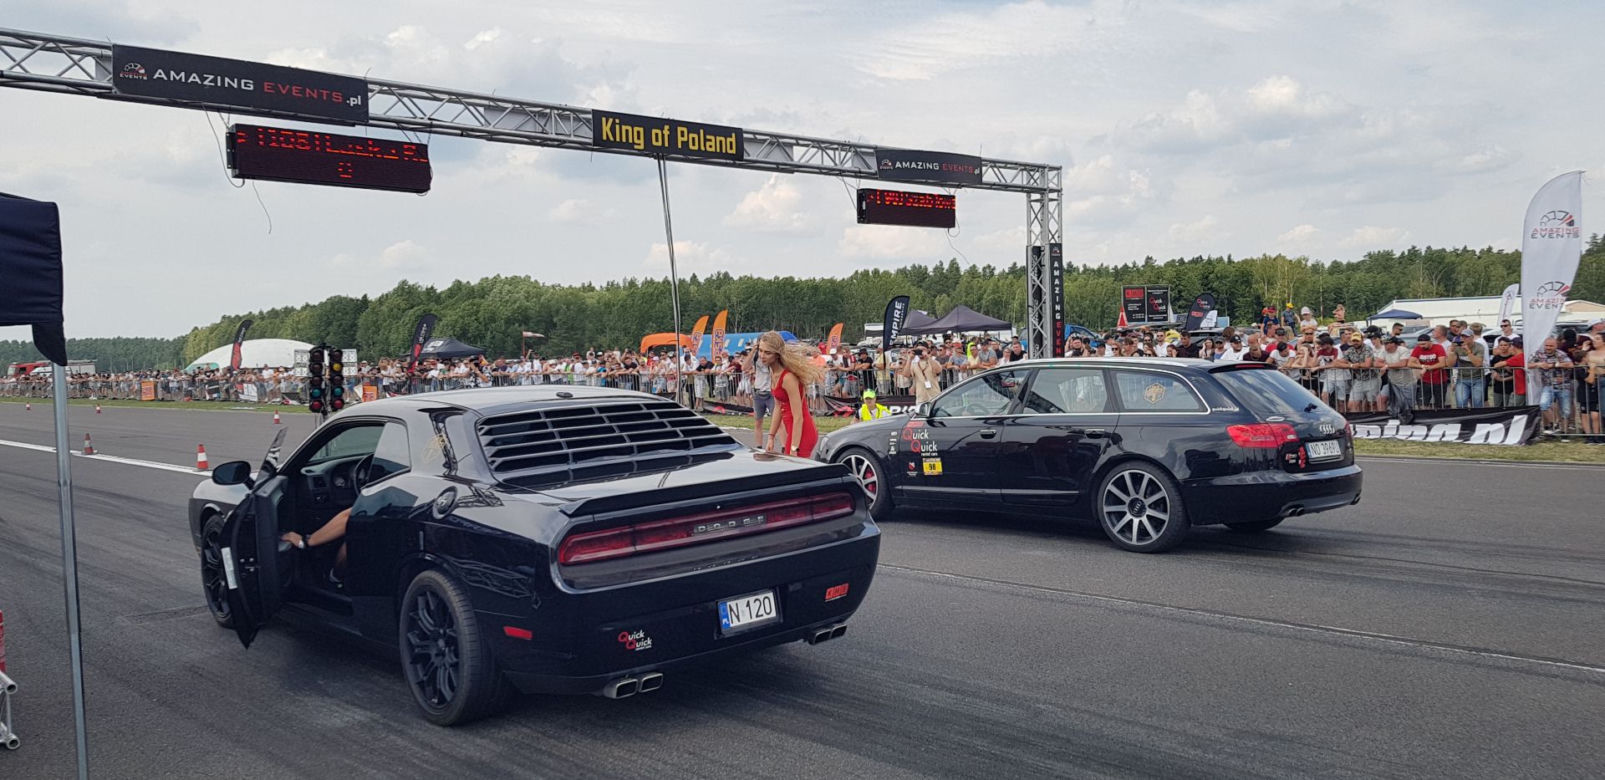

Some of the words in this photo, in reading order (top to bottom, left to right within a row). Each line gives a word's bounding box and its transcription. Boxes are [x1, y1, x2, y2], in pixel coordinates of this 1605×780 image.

[153, 69, 254, 91] AMAZING
[263, 81, 343, 103] EVENTS
[346, 95, 362, 107] .pl
[601, 116, 645, 150] King
[651, 124, 670, 148] of
[677, 126, 737, 155] Poland
[895, 161, 940, 171] AMAZING
[942, 163, 973, 175] EVENTS
[1531, 226, 1581, 235] AMAZING
[1053, 260, 1062, 320] AMAZING
[889, 301, 902, 346] EMPIRE
[1055, 321, 1063, 358] EVEN
[903, 427, 929, 441] Quick
[911, 439, 938, 453] Quick
[728, 602, 741, 624] N
[746, 595, 773, 620] 120
[618, 629, 645, 643] Quick
[626, 637, 652, 650] Quick
